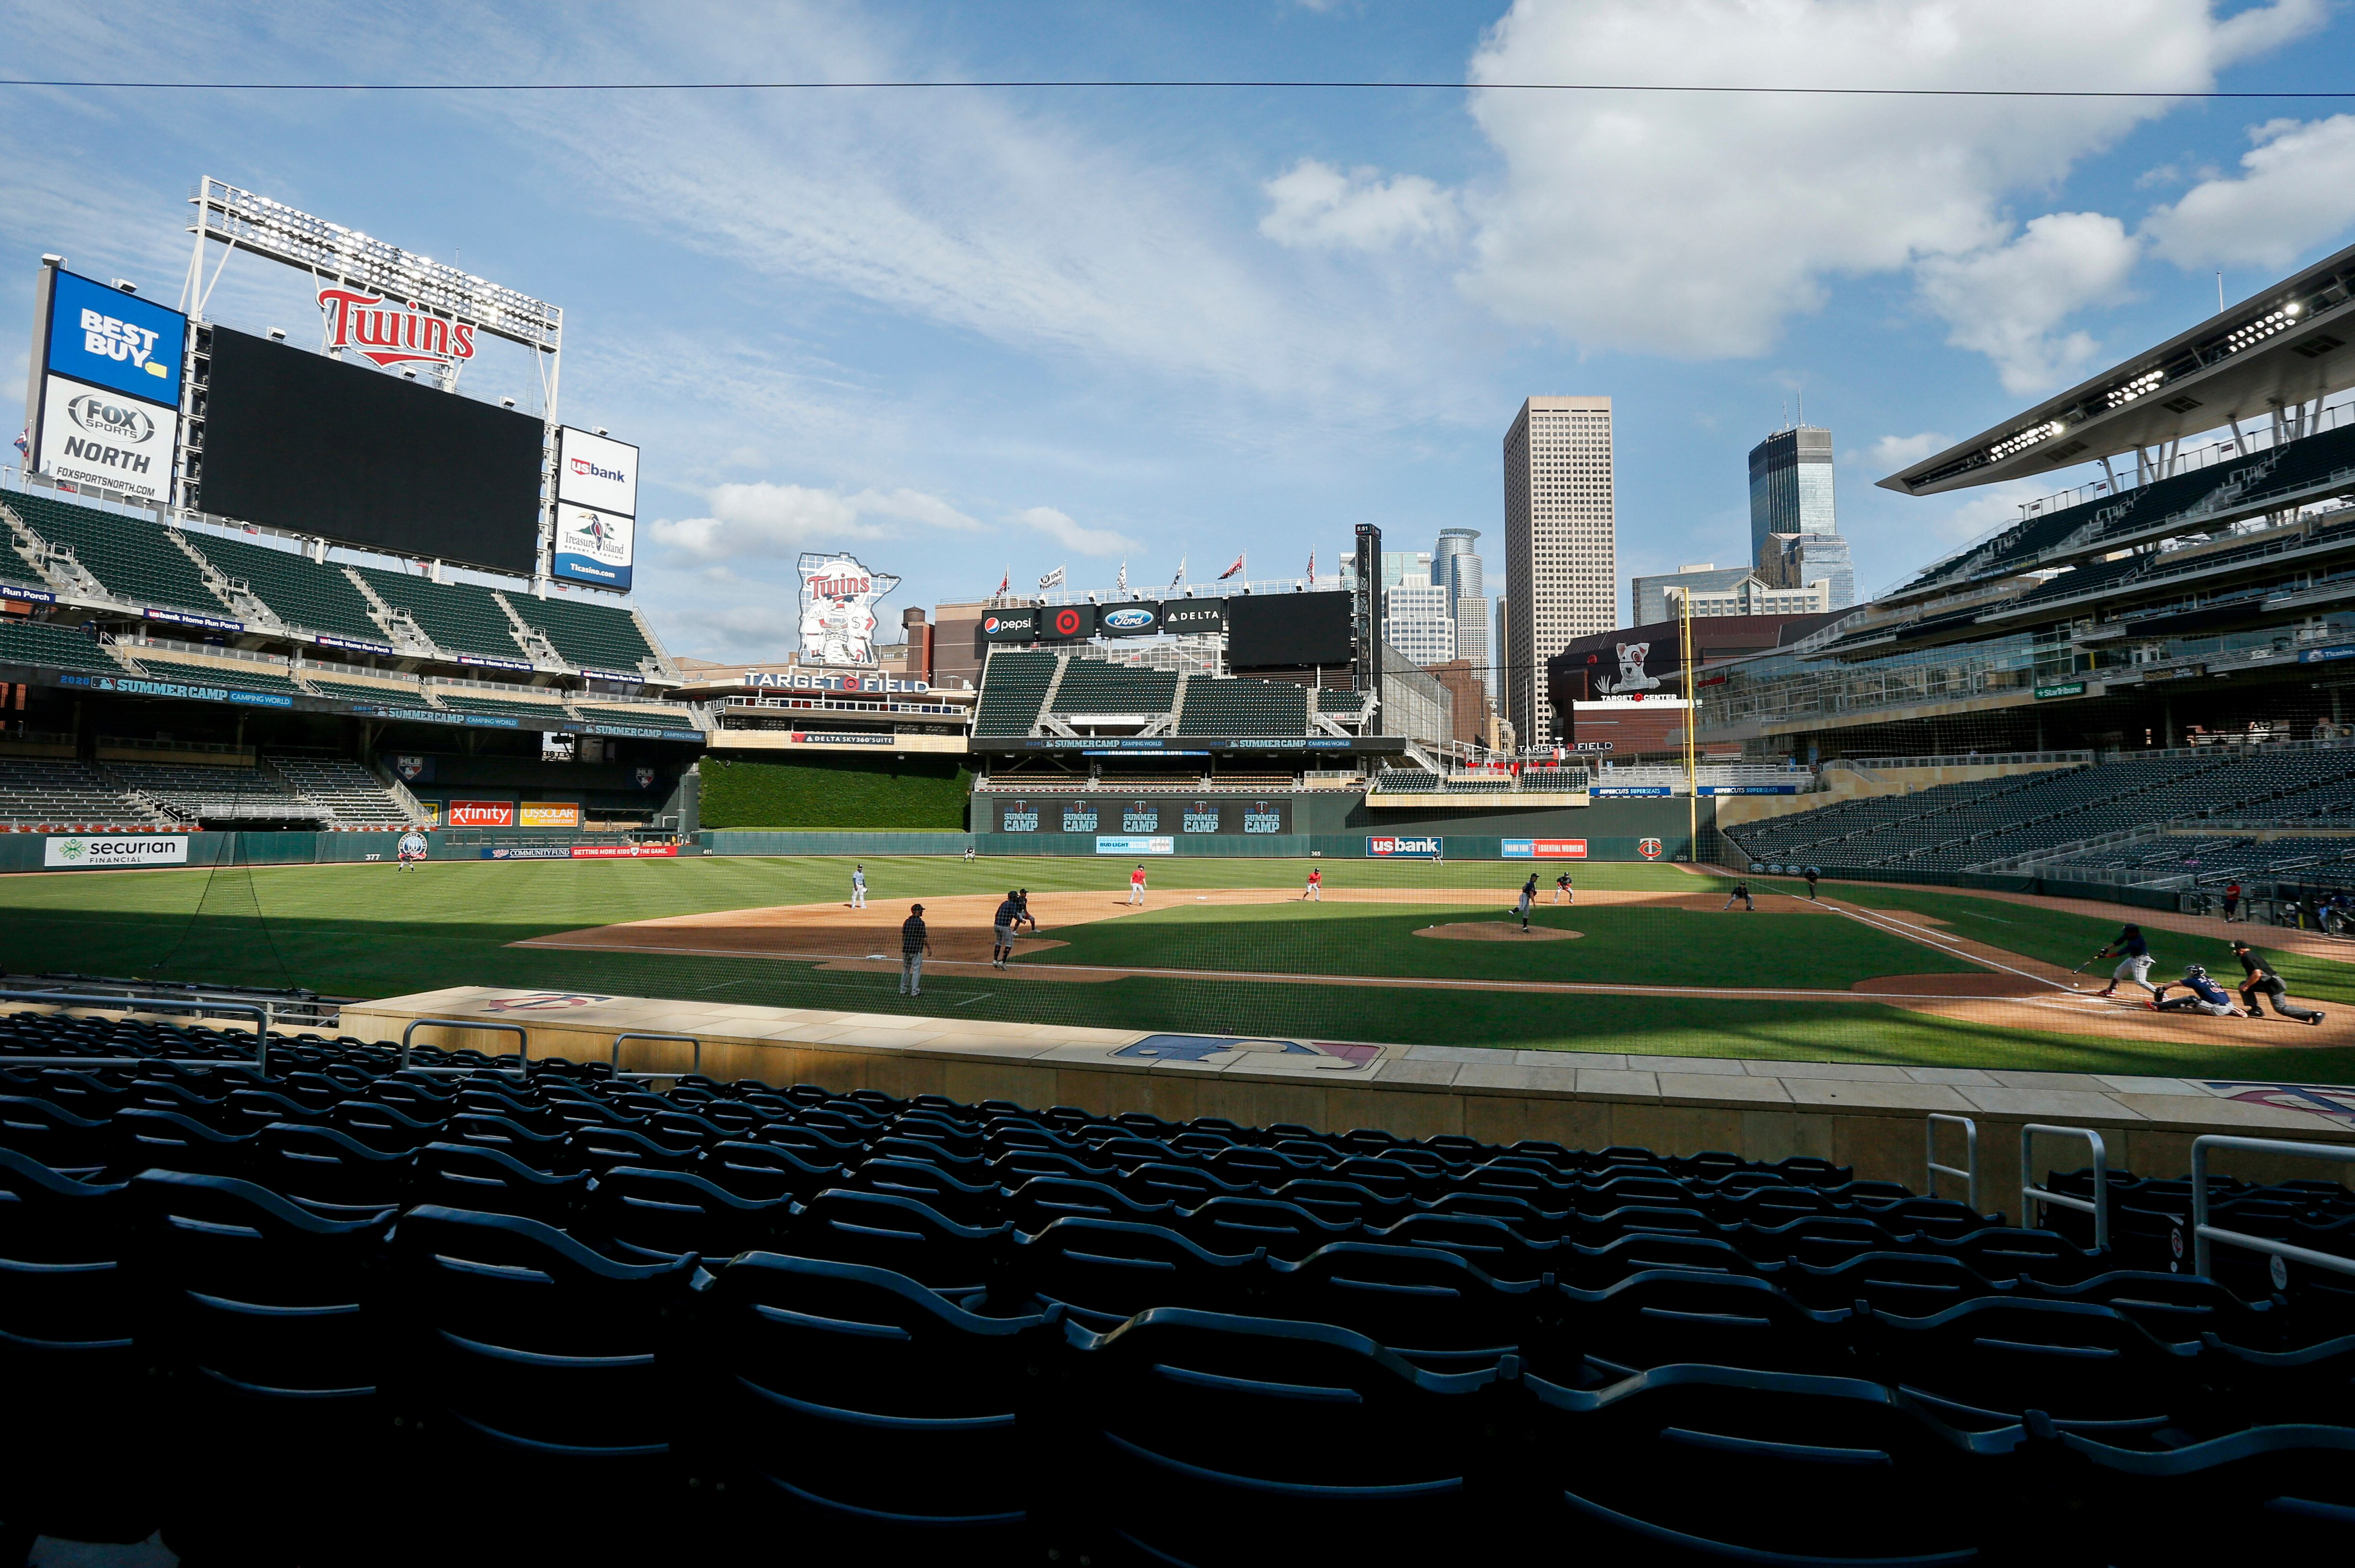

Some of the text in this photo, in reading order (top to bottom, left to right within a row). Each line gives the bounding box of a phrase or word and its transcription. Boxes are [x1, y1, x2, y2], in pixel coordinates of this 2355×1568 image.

[80, 308, 159, 350] BEST
[316, 287, 476, 360] Twins
[85, 331, 151, 368] BUY
[87, 399, 138, 429] FOX
[86, 419, 137, 438] SPORTS
[64, 436, 150, 474] NORTH
[56, 466, 155, 497] FOXSPORTSNORTH.COM
[564, 532, 624, 554] Treasure Island
[564, 545, 589, 554] RESORT
[807, 573, 870, 600] Twins
[3, 587, 50, 601] Run Porch
[182, 615, 204, 625] Home
[220, 622, 240, 630] Porch
[1114, 613, 1144, 628] Ford
[1181, 610, 1220, 621] DELTA
[1001, 618, 1032, 632] pepsi
[61, 675, 228, 700] 2020 SUMMER CAMP
[745, 672, 930, 694] TARGET FIELD
[2044, 686, 2082, 697] StarTribune
[231, 693, 289, 705] CAMPING WORLD
[388, 708, 434, 722] SUMMER
[434, 712, 464, 723] CAMP
[595, 725, 637, 736] SUMMER
[637, 728, 662, 738] CAMP
[1518, 745, 1563, 753] TARGET
[452, 804, 510, 823] xfinity
[1004, 821, 1038, 832] CAMP
[1063, 821, 1098, 832] CAMP
[1123, 821, 1158, 832] CAMP
[1184, 821, 1219, 833] CAMP
[1244, 822, 1280, 833] CAMP
[90, 842, 175, 855] securian
[492, 849, 509, 858] Twins
